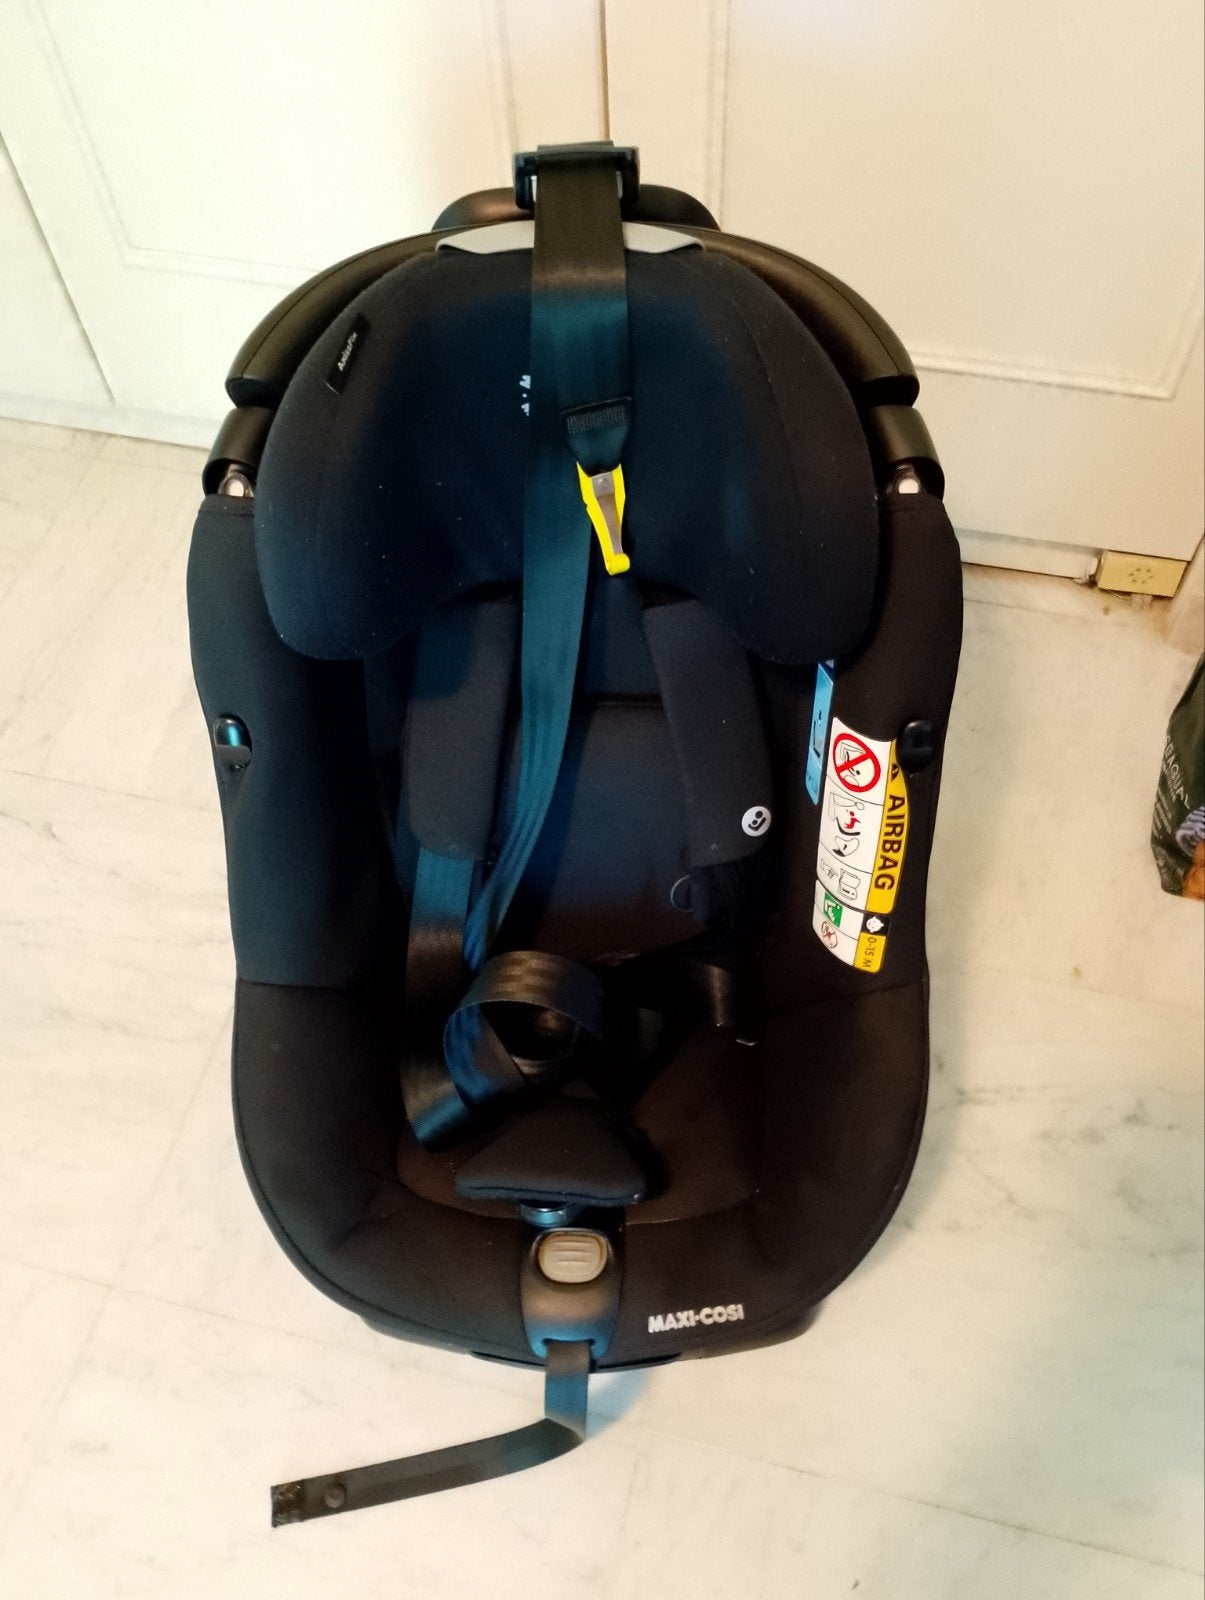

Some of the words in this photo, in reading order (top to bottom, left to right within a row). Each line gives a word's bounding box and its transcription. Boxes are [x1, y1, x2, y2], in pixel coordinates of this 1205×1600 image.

[874, 794, 906, 891] AIRBAG
[864, 936, 878, 956] 0-15
[861, 960, 872, 969] M
[647, 1303, 745, 1334] MAXI-COSI
